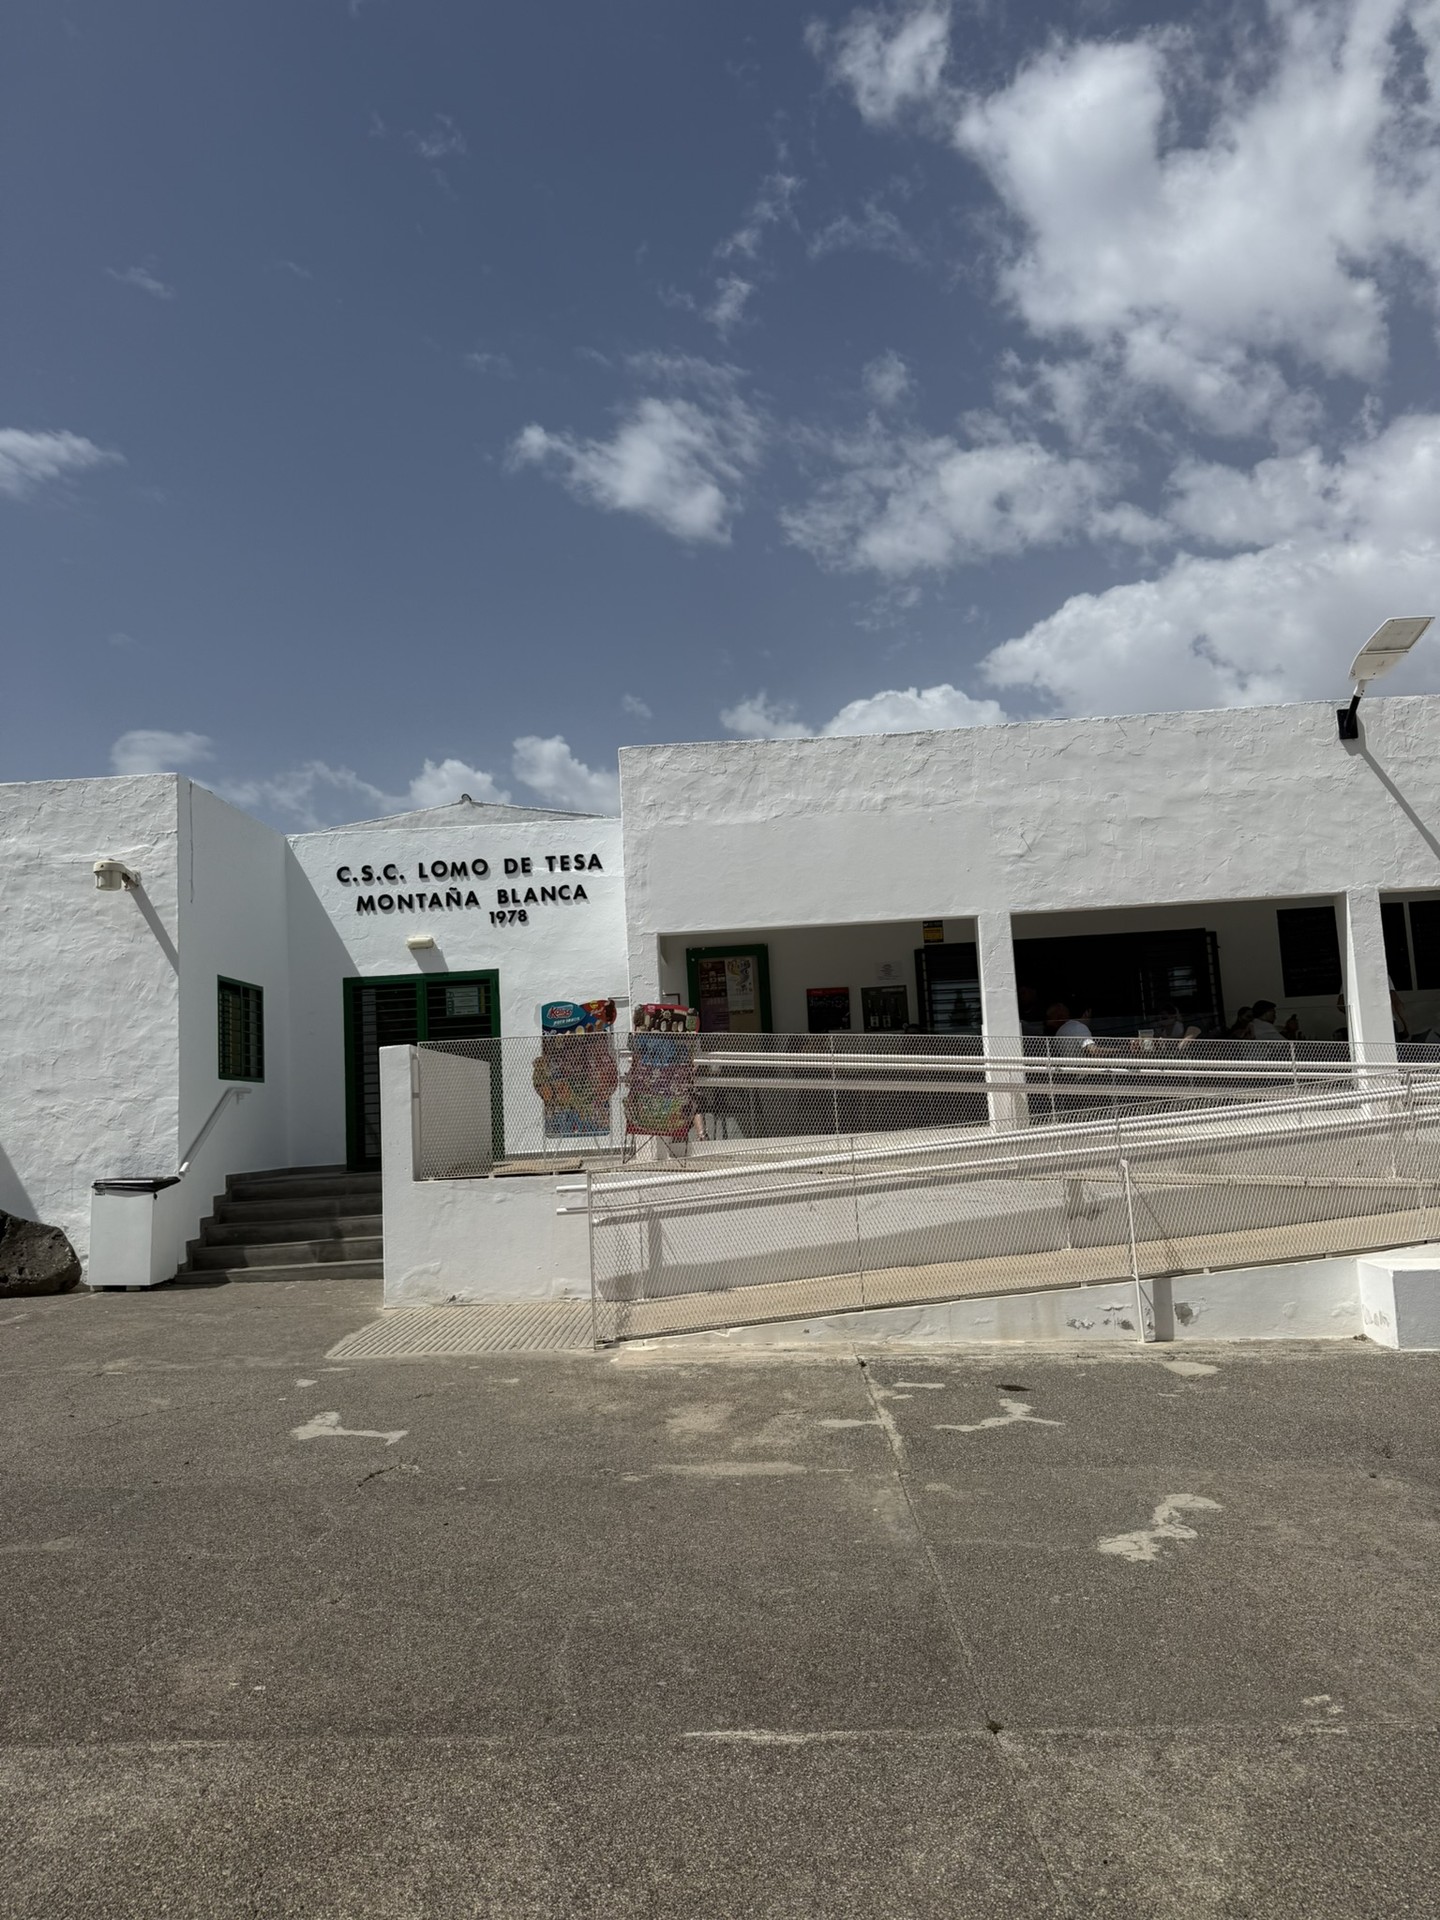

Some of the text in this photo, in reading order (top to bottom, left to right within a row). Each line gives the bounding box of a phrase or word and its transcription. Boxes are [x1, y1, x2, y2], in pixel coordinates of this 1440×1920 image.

[337, 853, 603, 883] C.S.C. LOMO DE TESA
[356, 884, 588, 912] MONTAÑA BLANCA
[489, 909, 527, 924] 1978
